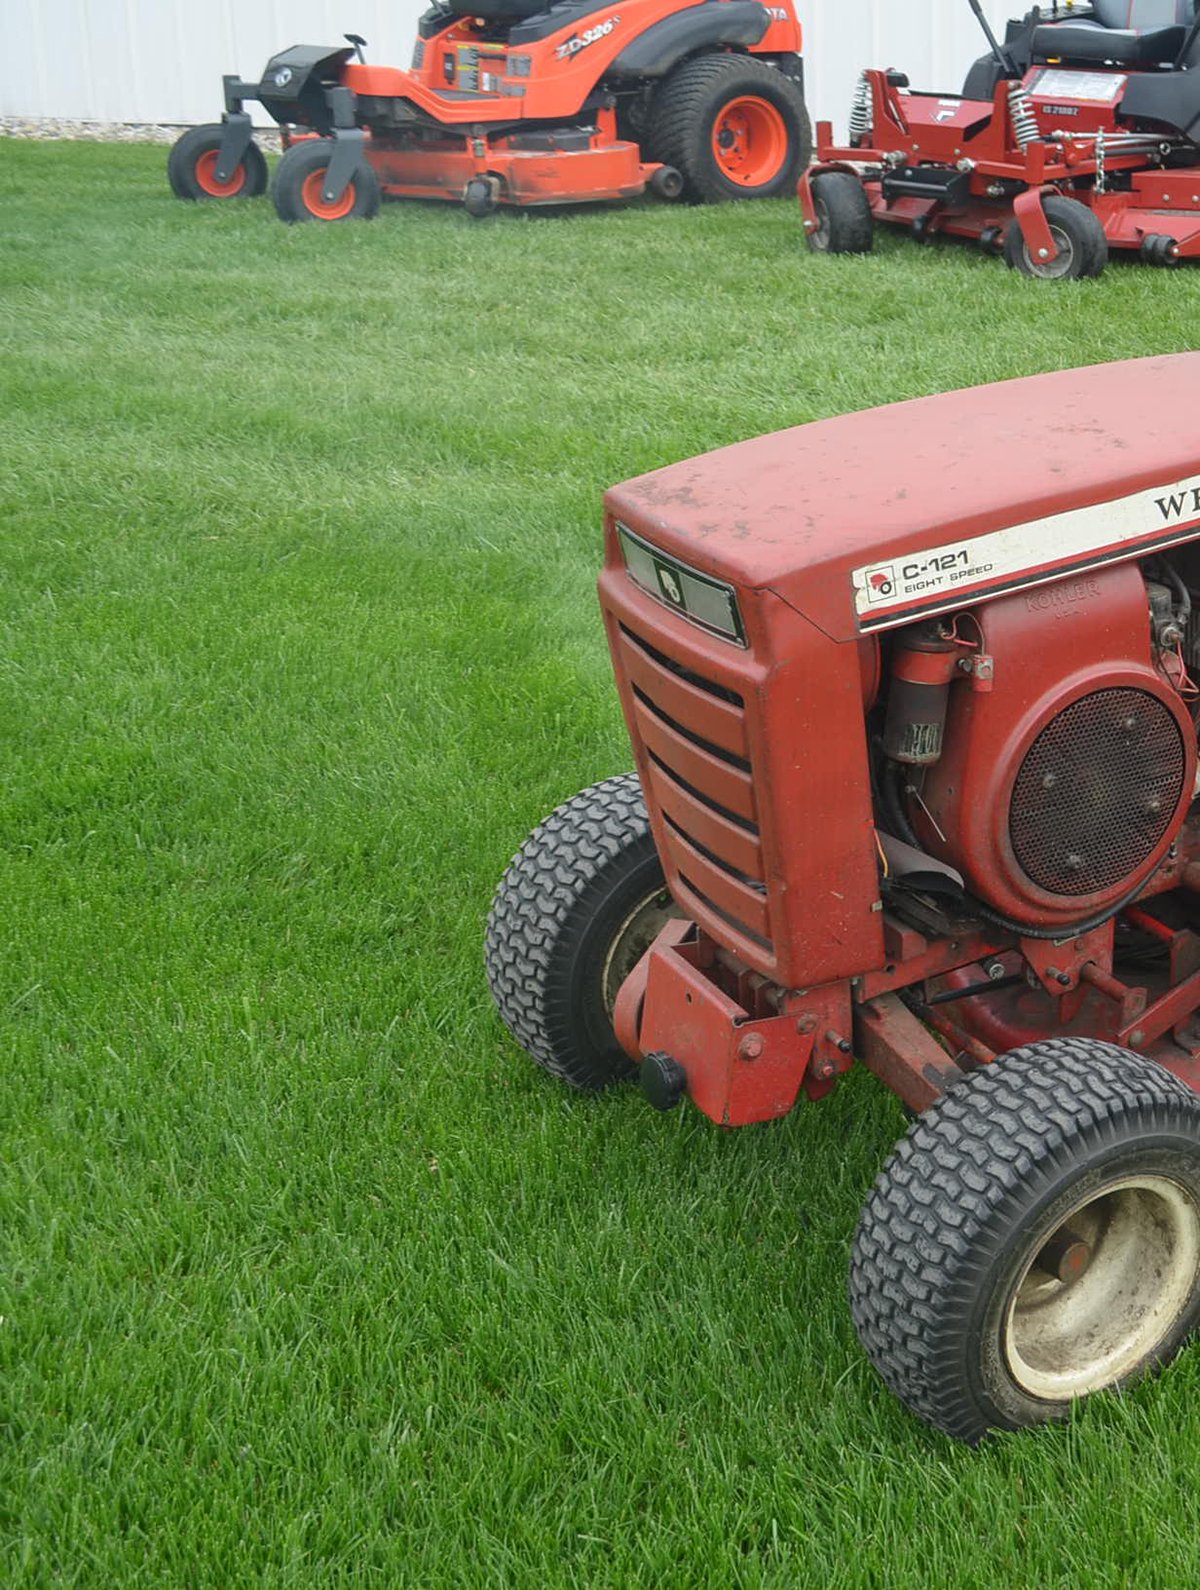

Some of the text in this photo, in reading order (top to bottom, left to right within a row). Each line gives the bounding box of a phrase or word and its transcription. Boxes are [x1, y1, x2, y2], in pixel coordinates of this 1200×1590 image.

[902, 550, 969, 580] C-121
[904, 563, 993, 593] EIGHT SPEED
[1024, 580, 1101, 612] KOHLER
